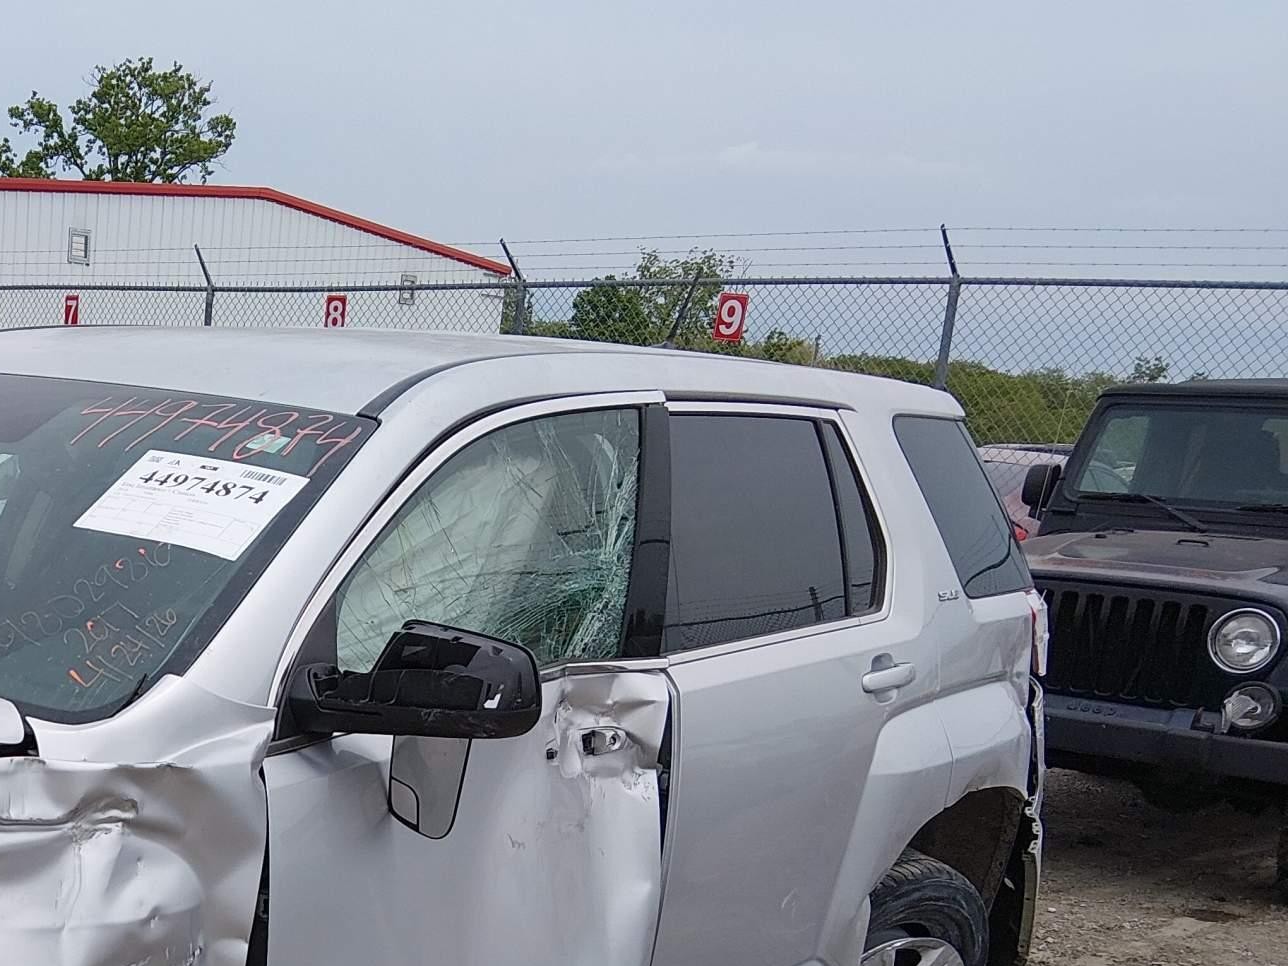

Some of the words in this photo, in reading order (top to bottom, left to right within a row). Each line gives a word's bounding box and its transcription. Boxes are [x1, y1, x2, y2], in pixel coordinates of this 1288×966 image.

[66, 300, 77, 325] 7
[328, 300, 343, 328] 8
[719, 299, 743, 336] 9
[70, 396, 362, 479] 44974874
[139, 470, 271, 505] 44974874
